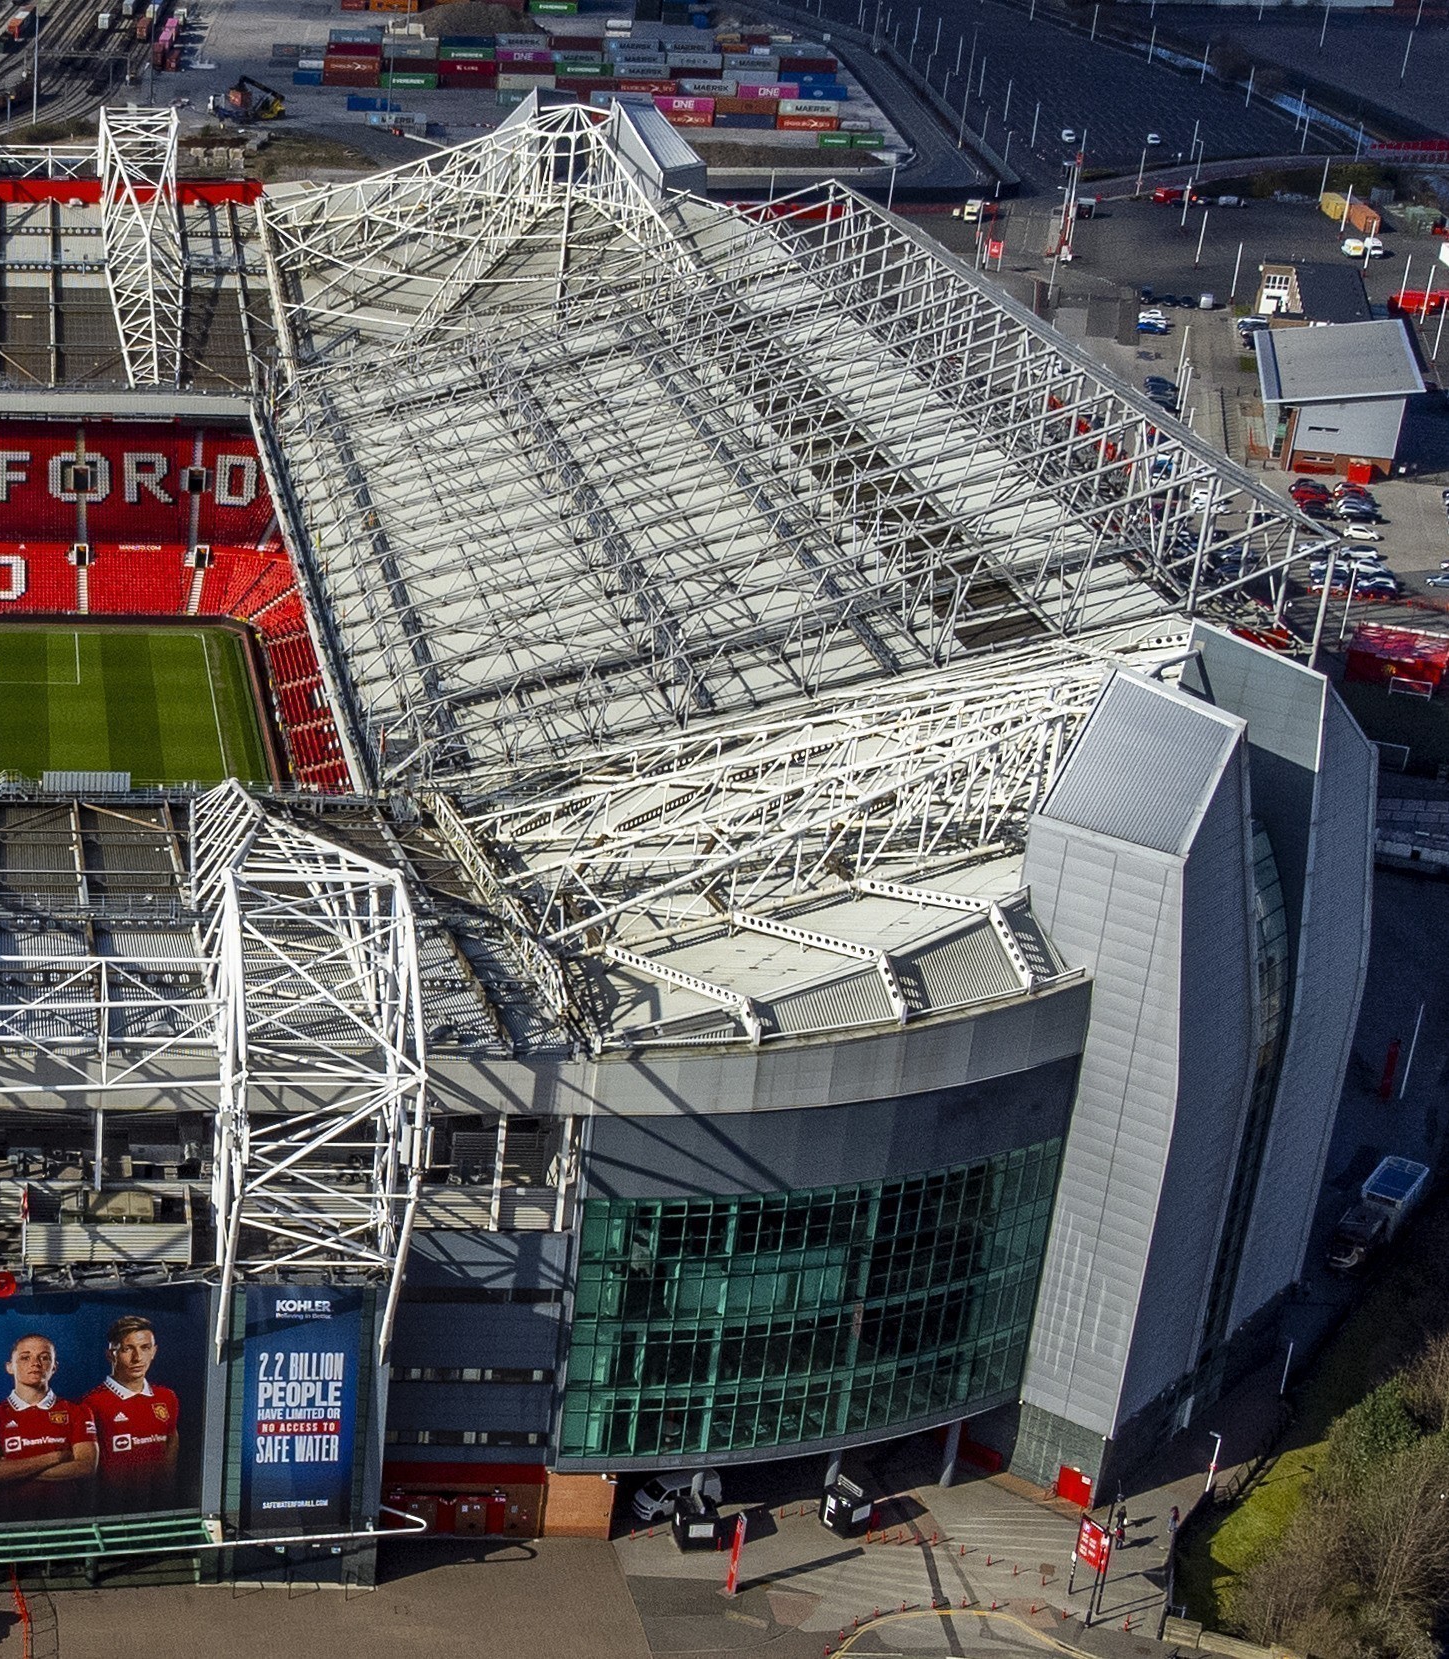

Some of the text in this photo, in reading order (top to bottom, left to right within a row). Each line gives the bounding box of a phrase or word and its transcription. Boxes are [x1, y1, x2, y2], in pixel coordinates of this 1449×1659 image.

[513, 52, 534, 61] ONE
[693, 84, 729, 92] MAERSK
[758, 87, 780, 97] ONE
[672, 99, 694, 109] ONE
[795, 104, 832, 113] MAERSK
[275, 1300, 331, 1312] KOHLER
[259, 1352, 344, 1381] 2.2 BILLION
[258, 1381, 342, 1408] PEOPLE
[257, 1408, 341, 1420] HAVE LIMITED OR
[261, 1422, 335, 1432] NO ACCESS TO
[256, 1435, 339, 1463] SAFE WATER
